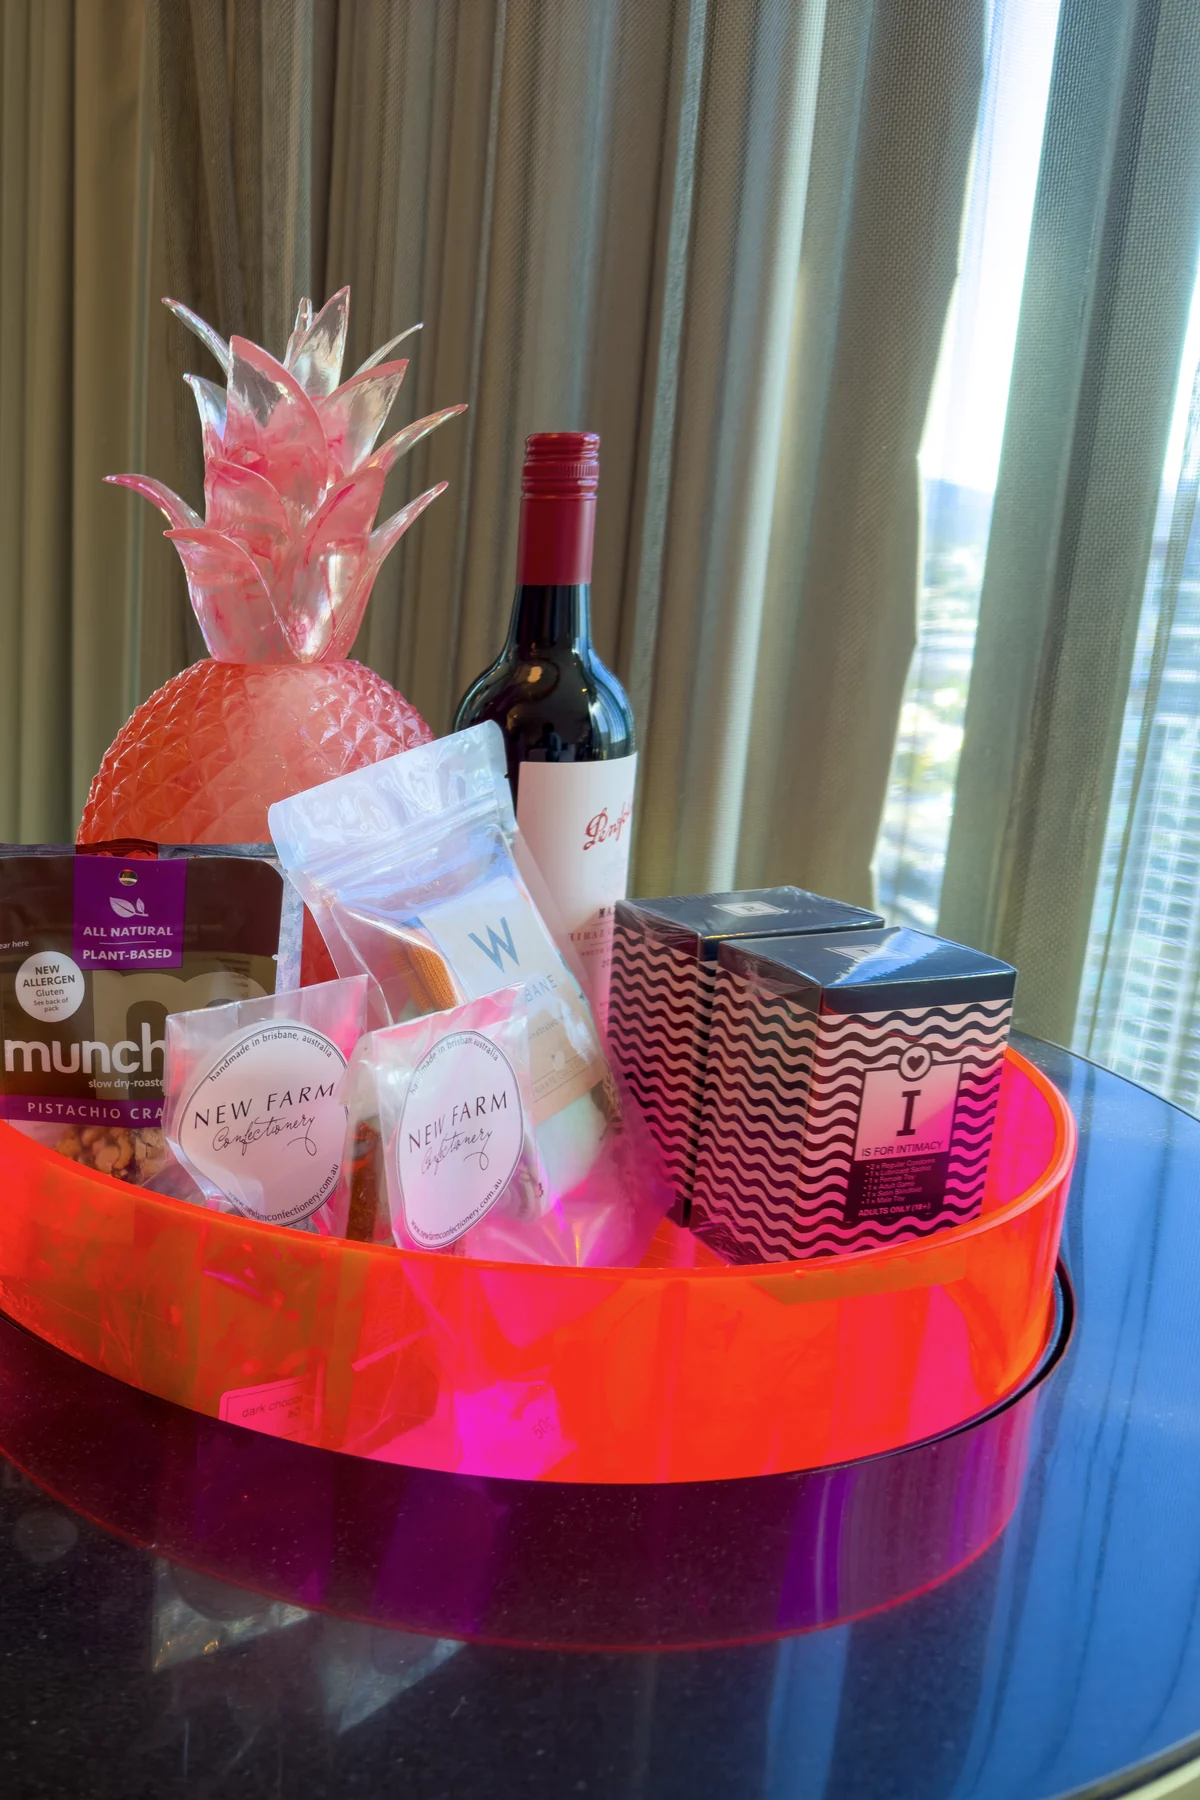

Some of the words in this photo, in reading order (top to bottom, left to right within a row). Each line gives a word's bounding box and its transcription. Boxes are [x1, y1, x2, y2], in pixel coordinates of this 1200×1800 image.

[83, 927, 107, 937] ALL
[110, 926, 174, 937] NATURAL
[12, 940, 30, 948] here
[467, 916, 520, 973] W
[82, 948, 172, 960] PLANT-BASED
[35, 965, 60, 976] NEW
[22, 975, 76, 988] ALLERGEN
[524, 974, 558, 1002] BANE
[36, 988, 64, 997] Gluten
[44, 1005, 60, 1013] pack
[45, 998, 62, 1006] back
[4, 1022, 165, 1074] munch
[438, 1046, 446, 1054] in
[209, 1044, 250, 1082] handmade
[252, 1038, 260, 1047] in
[262, 1030, 299, 1042] brisbane,
[302, 1035, 332, 1058] australia
[88, 1079, 112, 1088] slow
[27, 1102, 121, 1119] PISTACHIO
[194, 1098, 252, 1129] NEW
[266, 1082, 335, 1112] FARM
[896, 1089, 922, 1137] I
[409, 1114, 446, 1154] NEW
[452, 1090, 507, 1126] FARM
[212, 1114, 318, 1156] Confectionery
[862, 1148, 872, 1157] IS
[874, 1146, 894, 1156] FOR
[896, 1140, 944, 1154] INTIMACY
[858, 1206, 888, 1217] ADULTS
[890, 1204, 911, 1214] ONLY
[242, 1403, 266, 1418] dark
